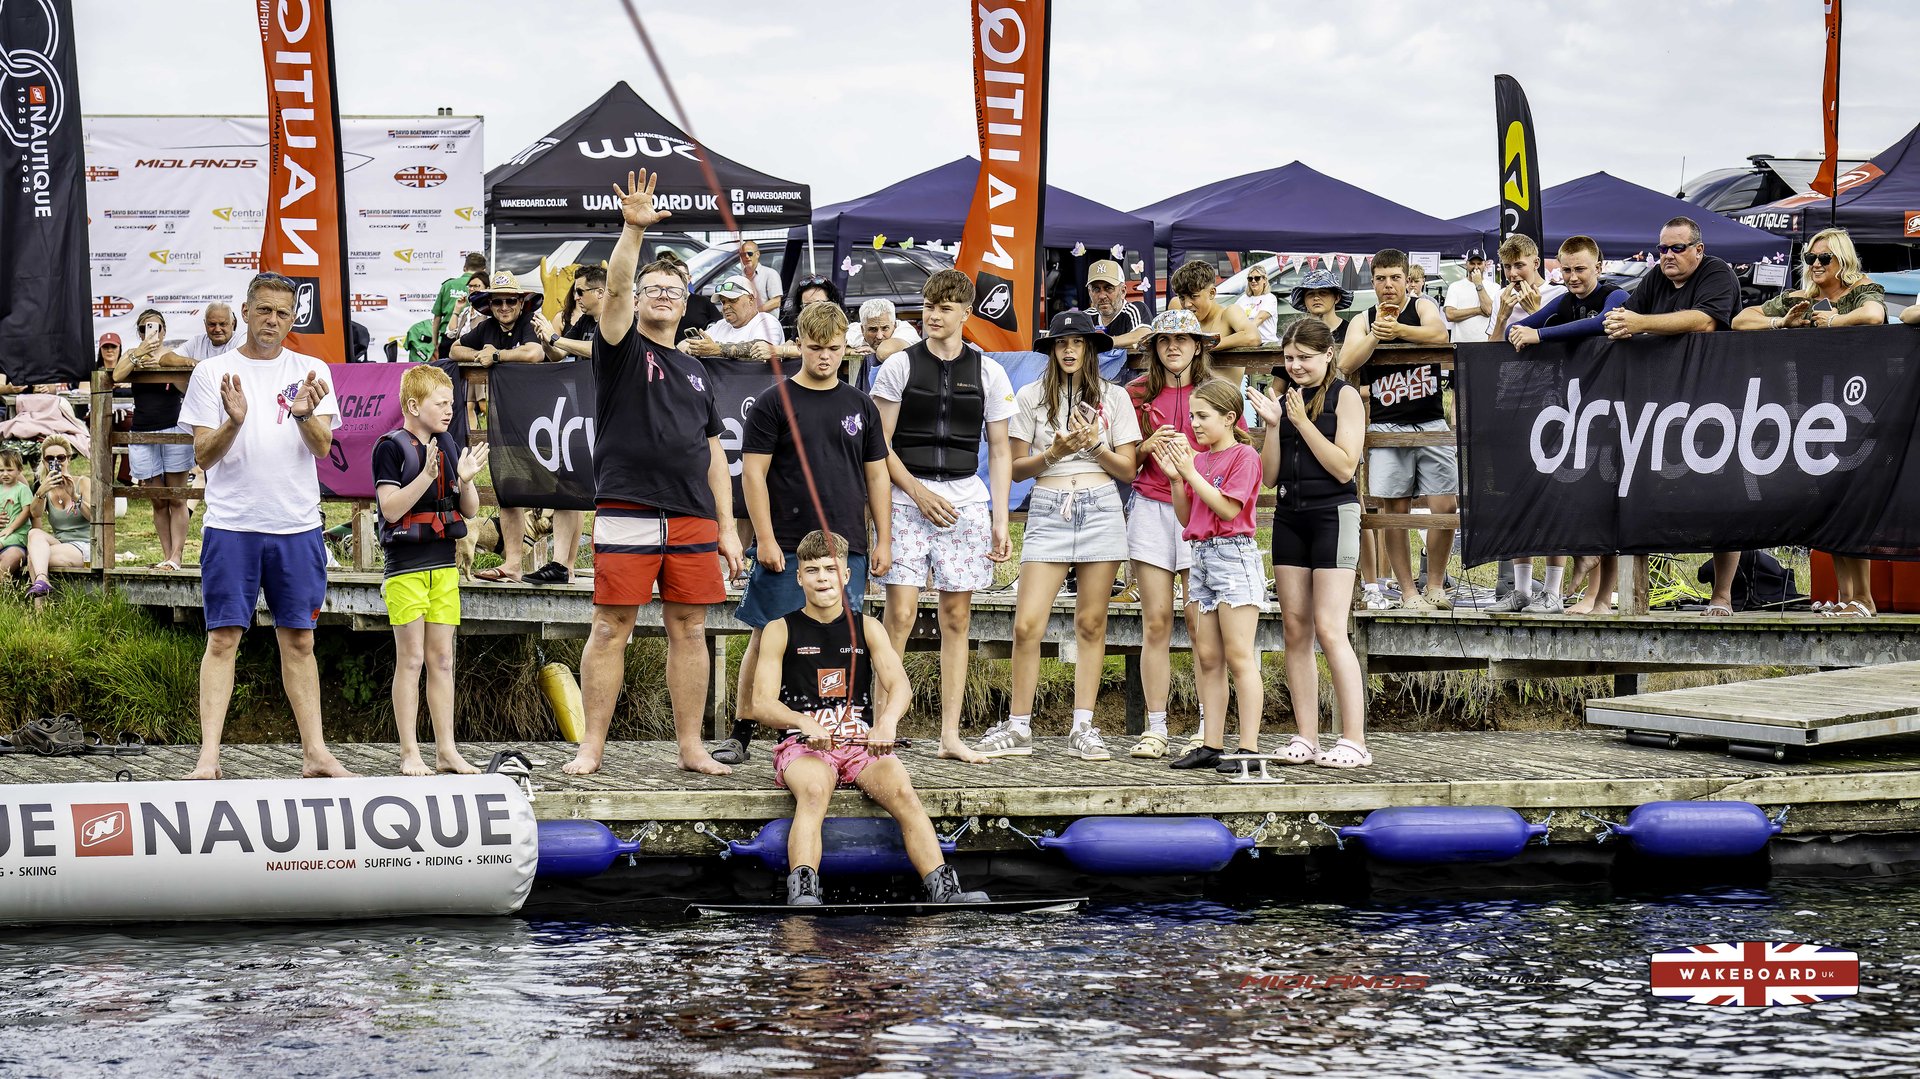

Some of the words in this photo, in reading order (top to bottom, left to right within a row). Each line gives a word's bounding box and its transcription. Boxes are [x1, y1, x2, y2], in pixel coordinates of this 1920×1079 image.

[17, 87, 27, 124] 1925
[29, 105, 52, 217] NAUTIQUE
[135, 159, 258, 169] MIDLANDS
[22, 154, 31, 193] 2025
[694, 194, 719, 210] UK
[746, 191, 802, 200] /WAKEBOARDUK
[500, 198, 568, 208] WAKEBOARD.CO.UK
[747, 204, 784, 213] @UKWAKE
[232, 208, 264, 217] central
[1740, 213, 1790, 230] NAUTIQUE
[169, 251, 201, 260] central
[412, 250, 443, 258] central
[1376, 364, 1431, 393] WAKE
[1380, 380, 1434, 406] OPEN
[140, 793, 513, 855] NAUTIQUE
[266, 858, 357, 872] NAUTIQUE.COM
[364, 857, 412, 868] SURFING
[425, 856, 463, 866] RIDING
[476, 854, 513, 864] SKIING
[19, 866, 57, 876] SKIING
